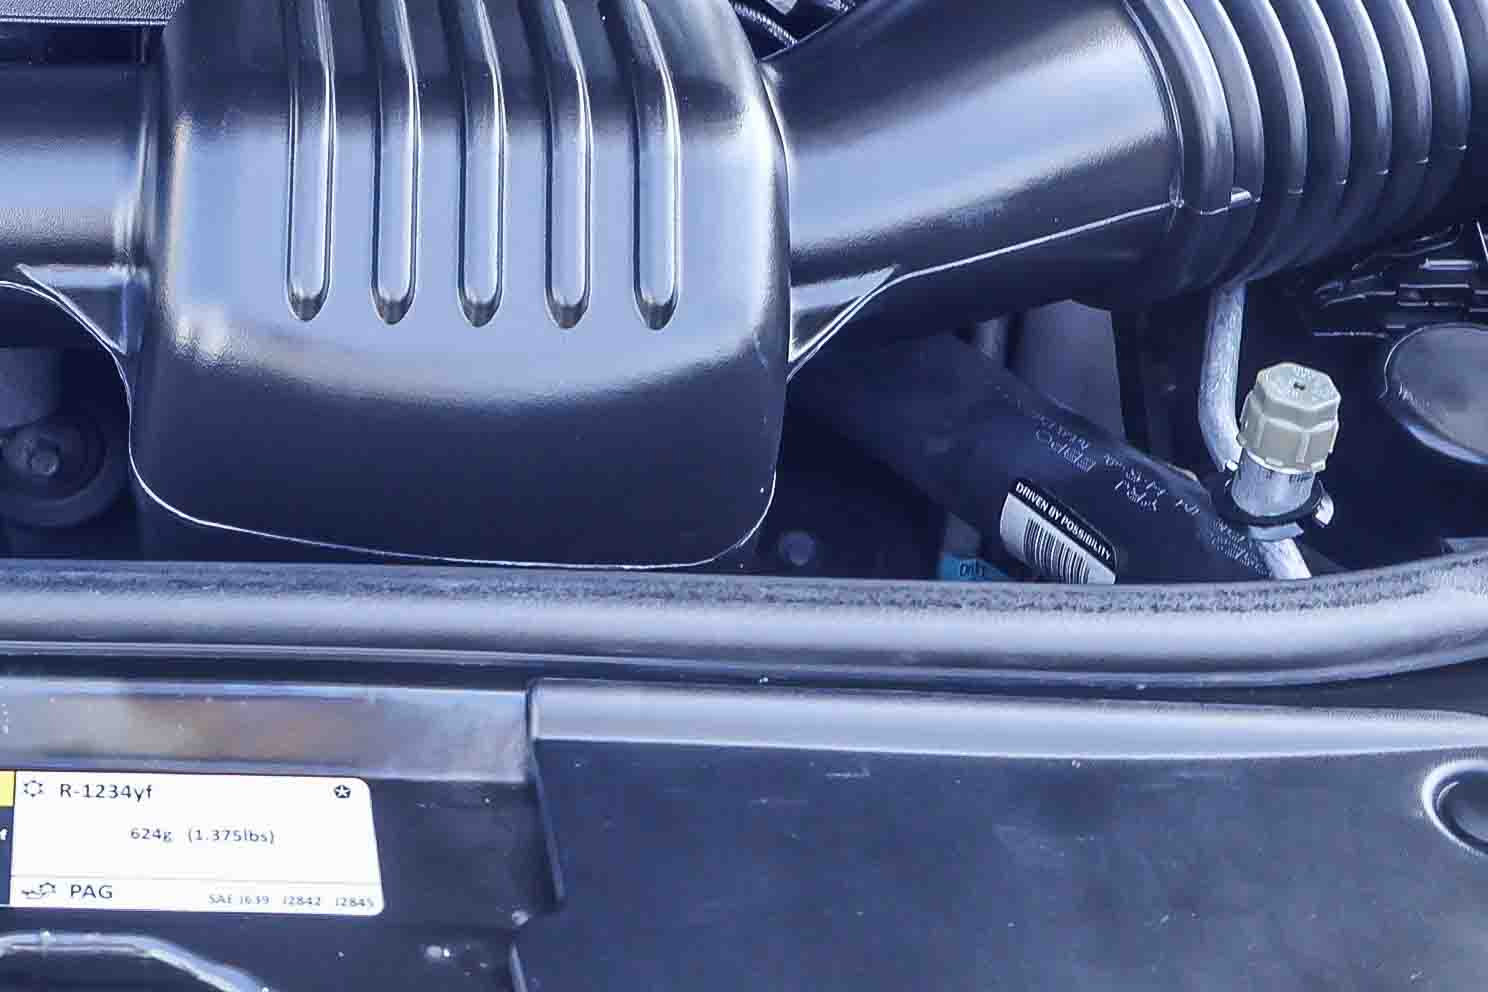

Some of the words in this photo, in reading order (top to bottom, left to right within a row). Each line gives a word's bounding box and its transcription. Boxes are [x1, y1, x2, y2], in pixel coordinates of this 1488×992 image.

[1015, 481, 1050, 512] DRIVEN
[1047, 505, 1062, 521] BY
[1060, 514, 1112, 561] POSSIBILITY
[59, 782, 153, 803] R-1234yf
[129, 827, 173, 843] 624g
[187, 827, 275, 845] (1.375lbs)
[69, 883, 114, 900] PAG
